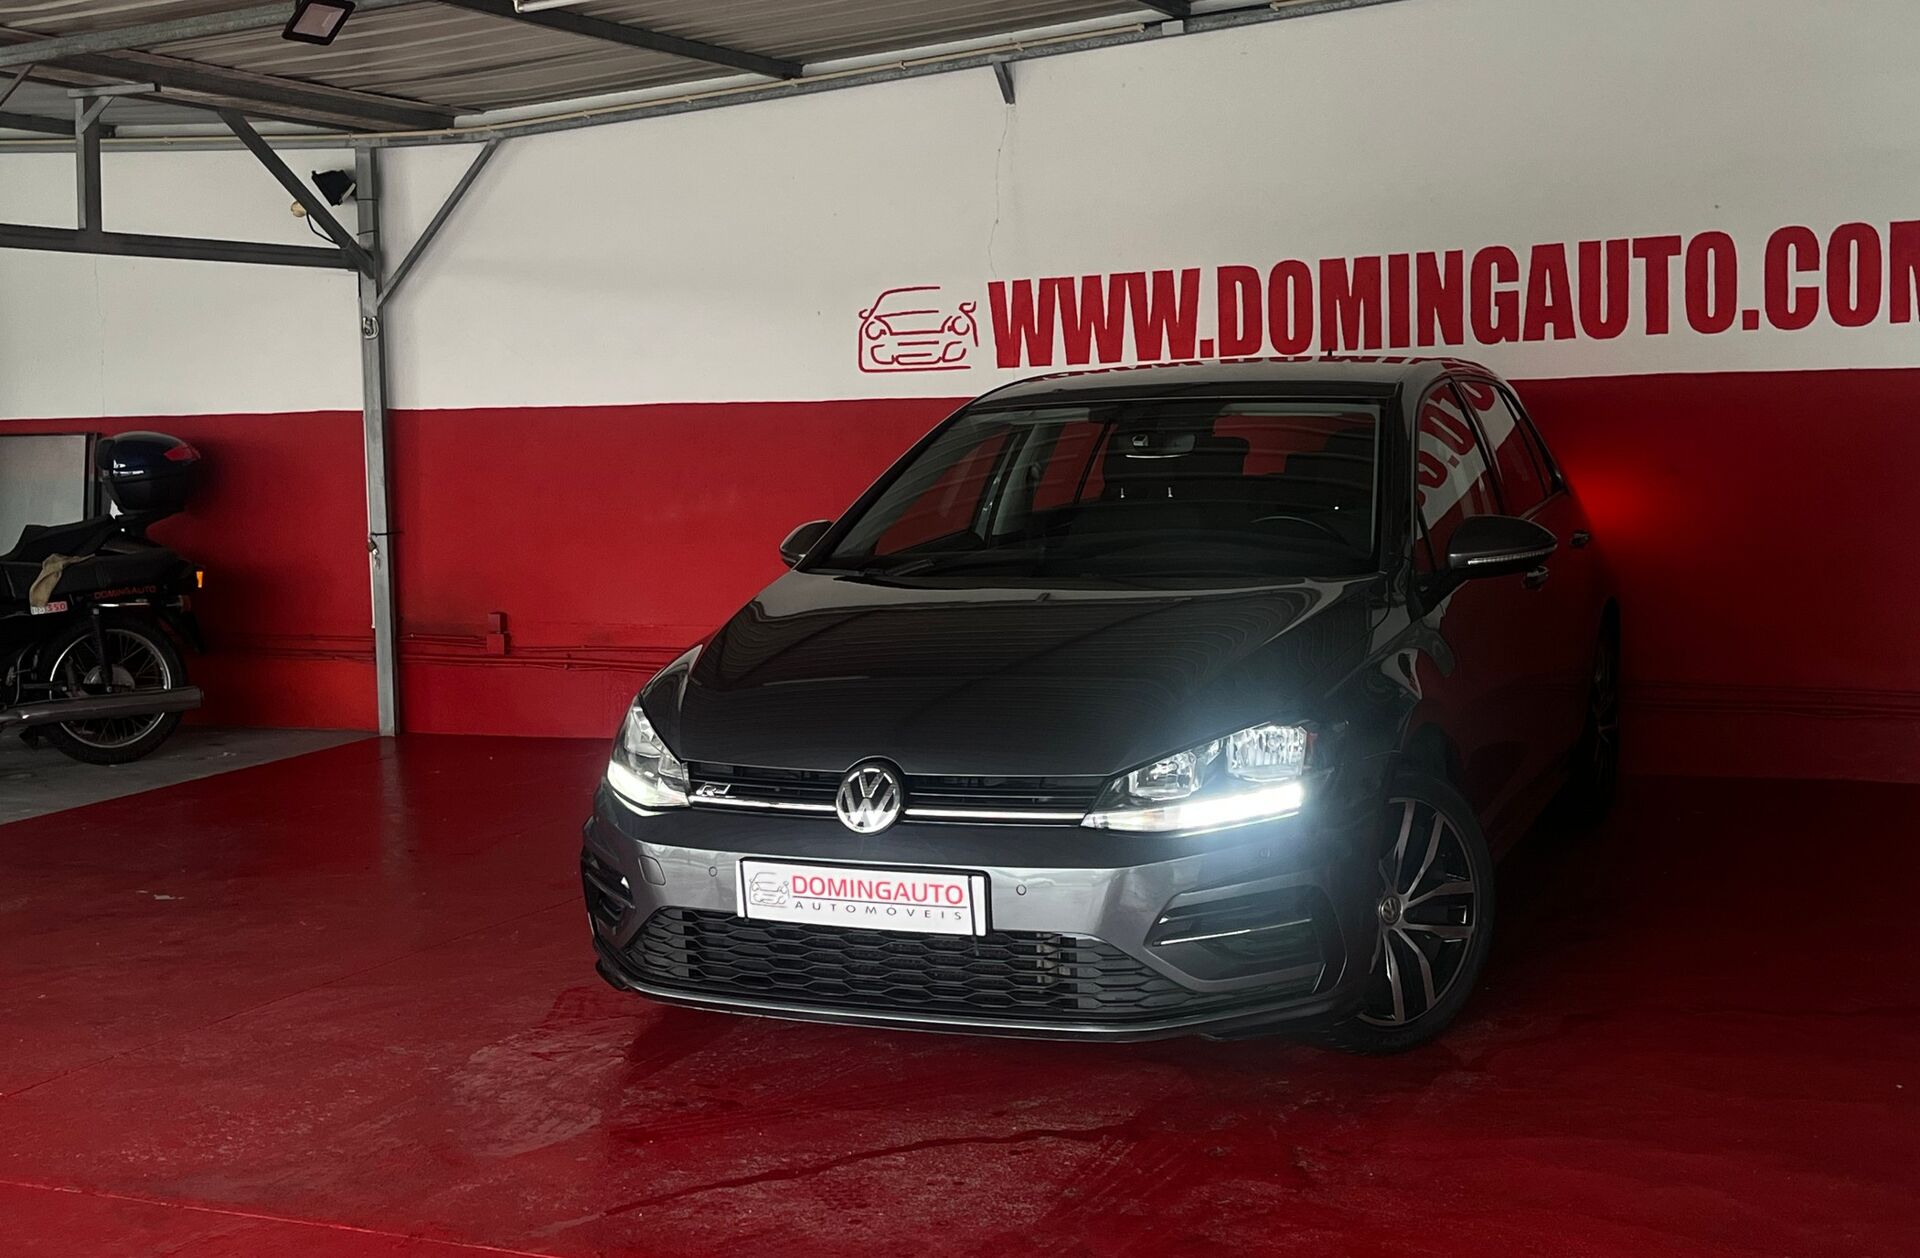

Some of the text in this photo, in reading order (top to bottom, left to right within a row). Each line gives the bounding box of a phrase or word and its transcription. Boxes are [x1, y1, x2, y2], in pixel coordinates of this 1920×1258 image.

[93, 584, 157, 600] DOMINGAUTO
[791, 875, 964, 905] DOMINGAUTO
[794, 901, 963, 921] AUTOMÓVEIS
